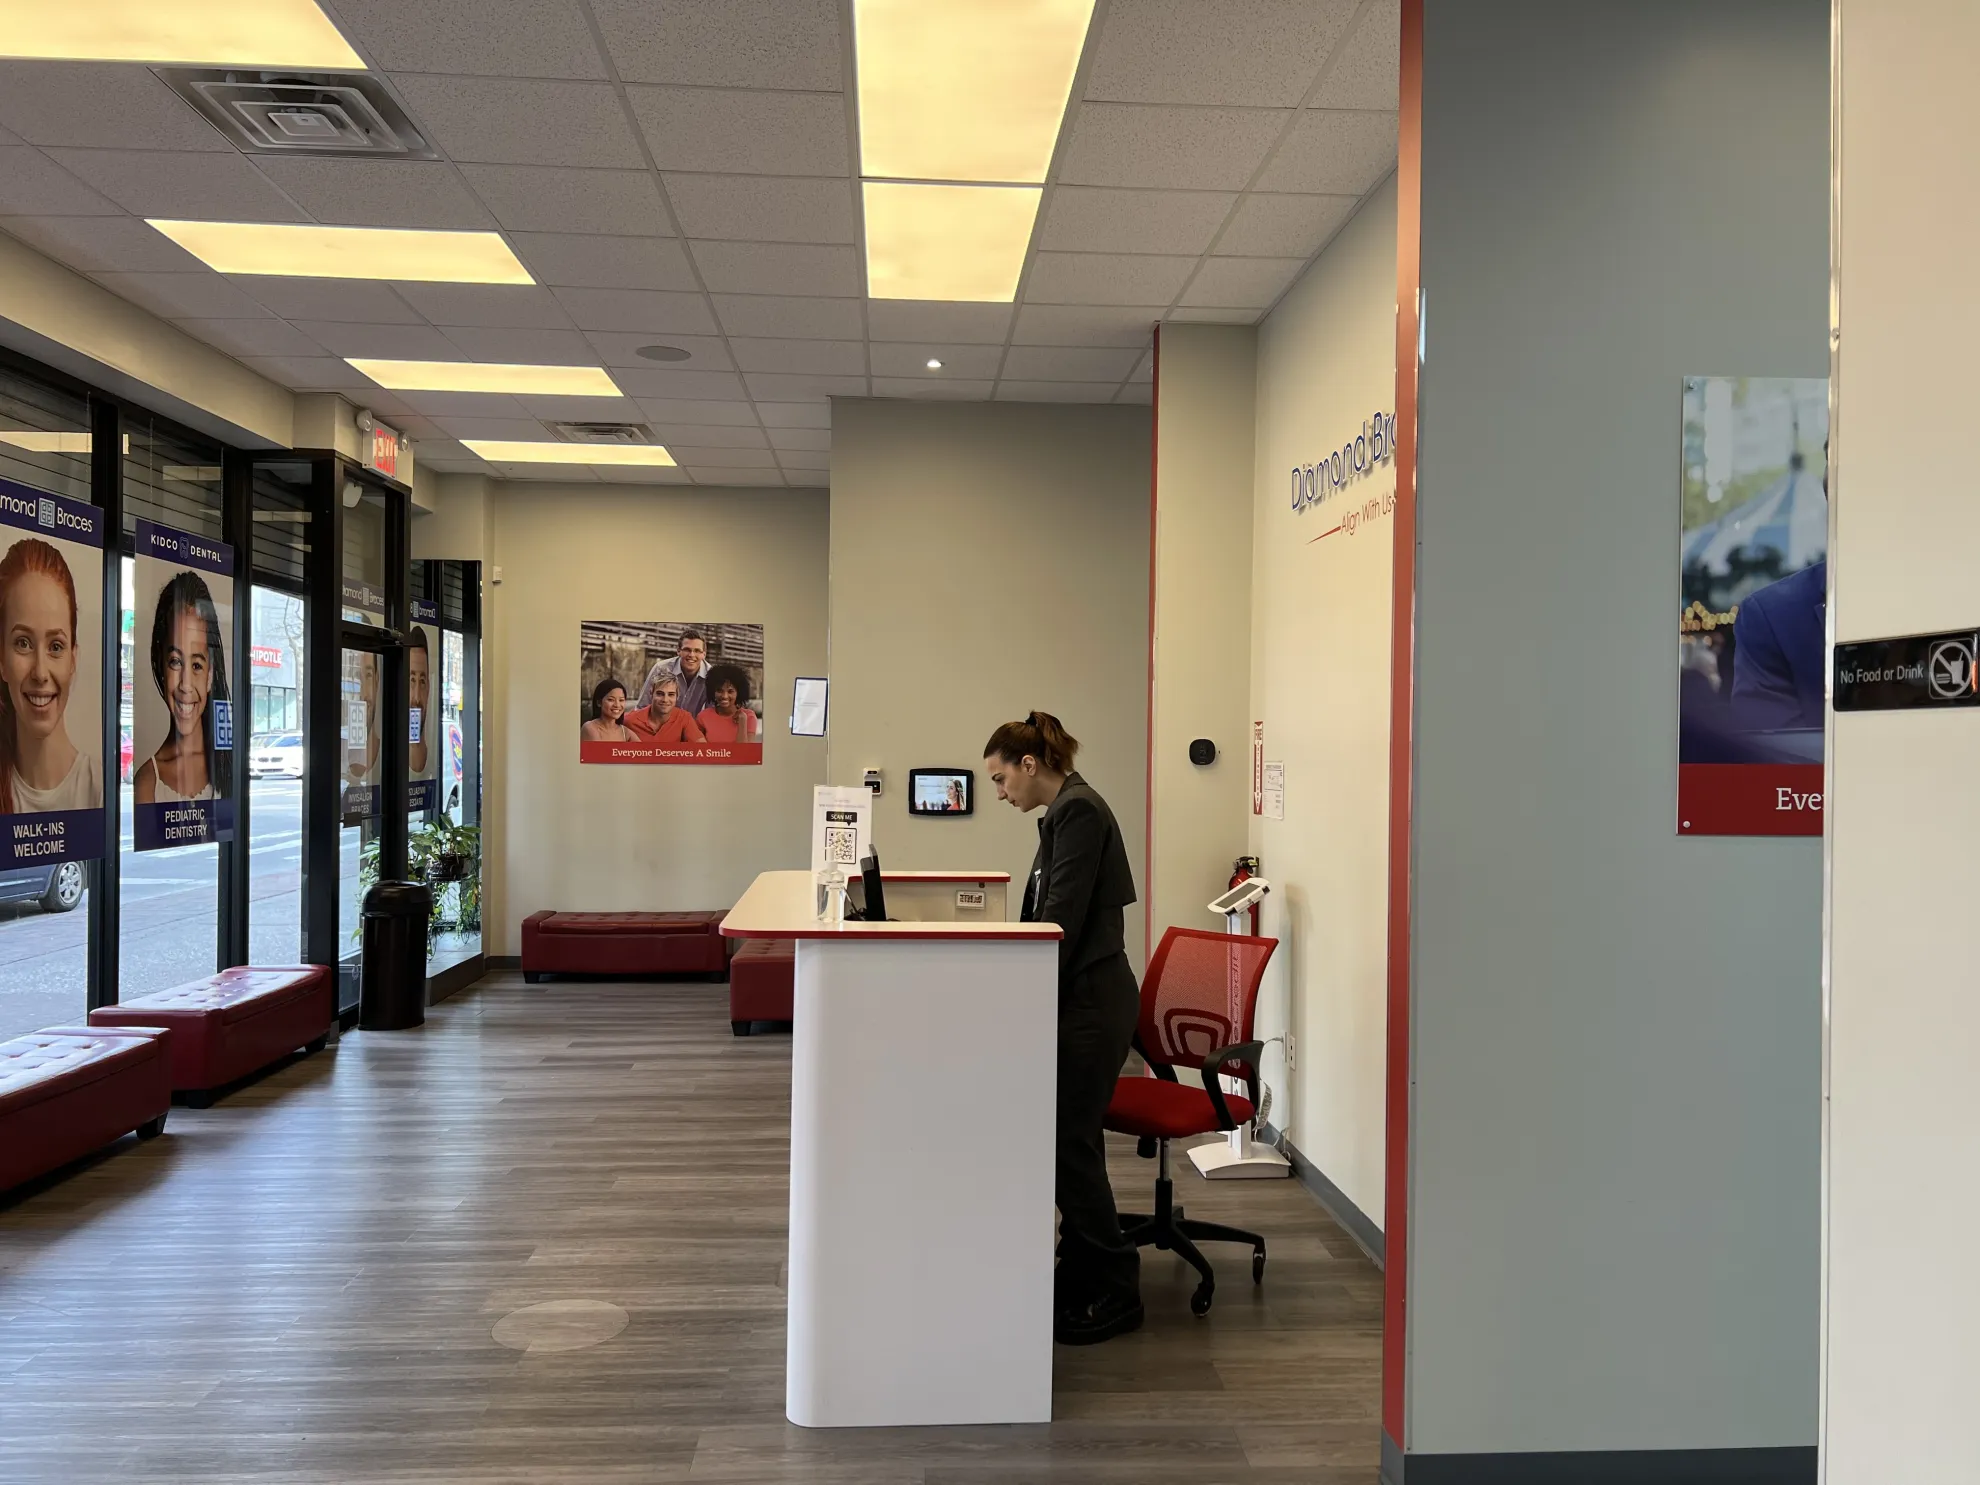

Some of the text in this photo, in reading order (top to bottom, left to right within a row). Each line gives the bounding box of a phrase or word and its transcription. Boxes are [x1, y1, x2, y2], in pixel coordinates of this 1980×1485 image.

[375, 428, 397, 476] EXIT
[1291, 419, 1367, 511] Diamond
[0, 494, 93, 533] mond Braces
[1341, 511, 1361, 536] Align
[1361, 497, 1380, 523] With
[150, 534, 222, 563] KIDCO DENTAL
[1840, 663, 1924, 684] No Food or Drink
[612, 748, 731, 758] Everyone Deserves A Smile
[1775, 787, 1824, 811] Eve
[165, 808, 205, 823] PEDIATRIC
[13, 821, 65, 839] WALK-INS
[165, 824, 208, 840] DENTISTRY
[13, 840, 65, 858] WELCOME
